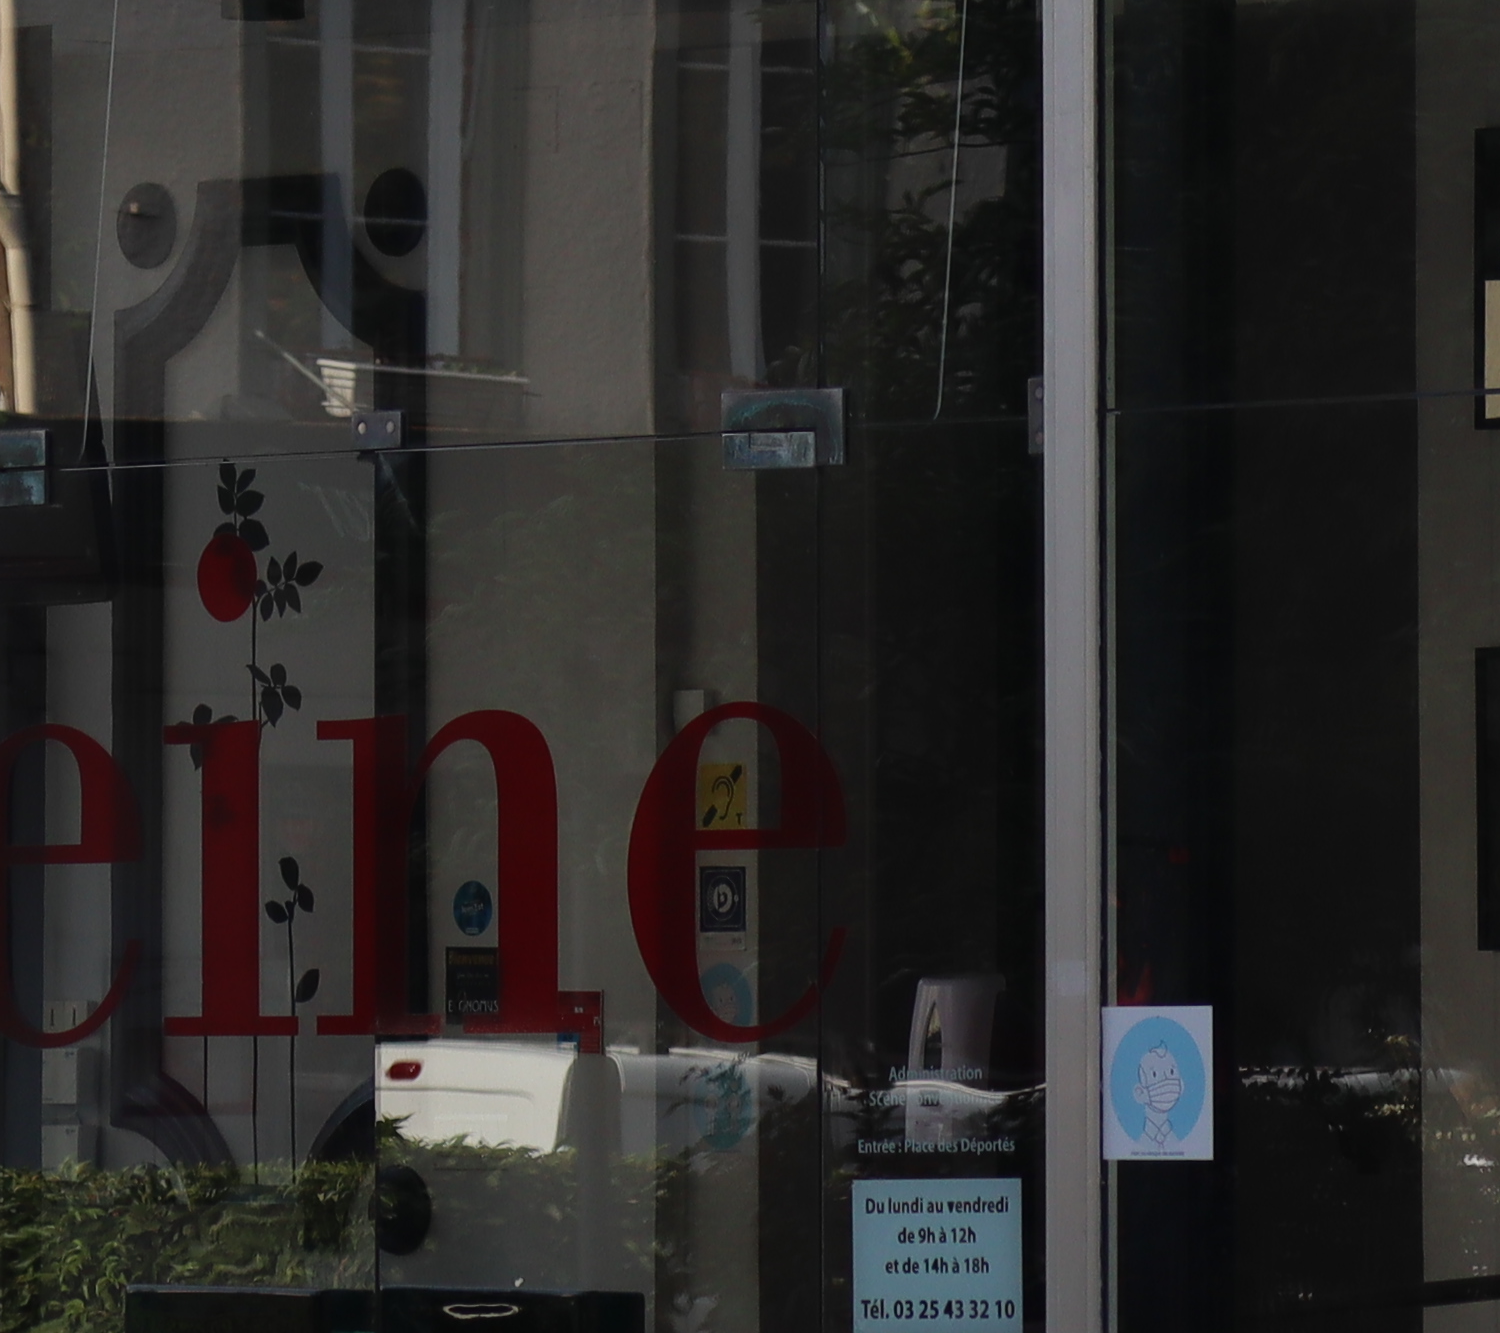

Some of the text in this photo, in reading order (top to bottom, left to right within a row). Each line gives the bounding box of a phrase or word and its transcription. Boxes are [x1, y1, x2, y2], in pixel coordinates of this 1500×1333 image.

[889, 1066, 982, 1081] Administration
[858, 1139, 895, 1154] Entrée
[905, 1139, 934, 1153] Place
[938, 1138, 958, 1153] des
[961, 1136, 1015, 1155] Déportés
[865, 1197, 1009, 1214] Du lundi au vendredi
[898, 1227, 976, 1244] de 9h à 12h
[885, 1257, 989, 1274] et de 14h à 18h
[861, 1299, 1015, 1319] Tél. 03 25 43 32 10
